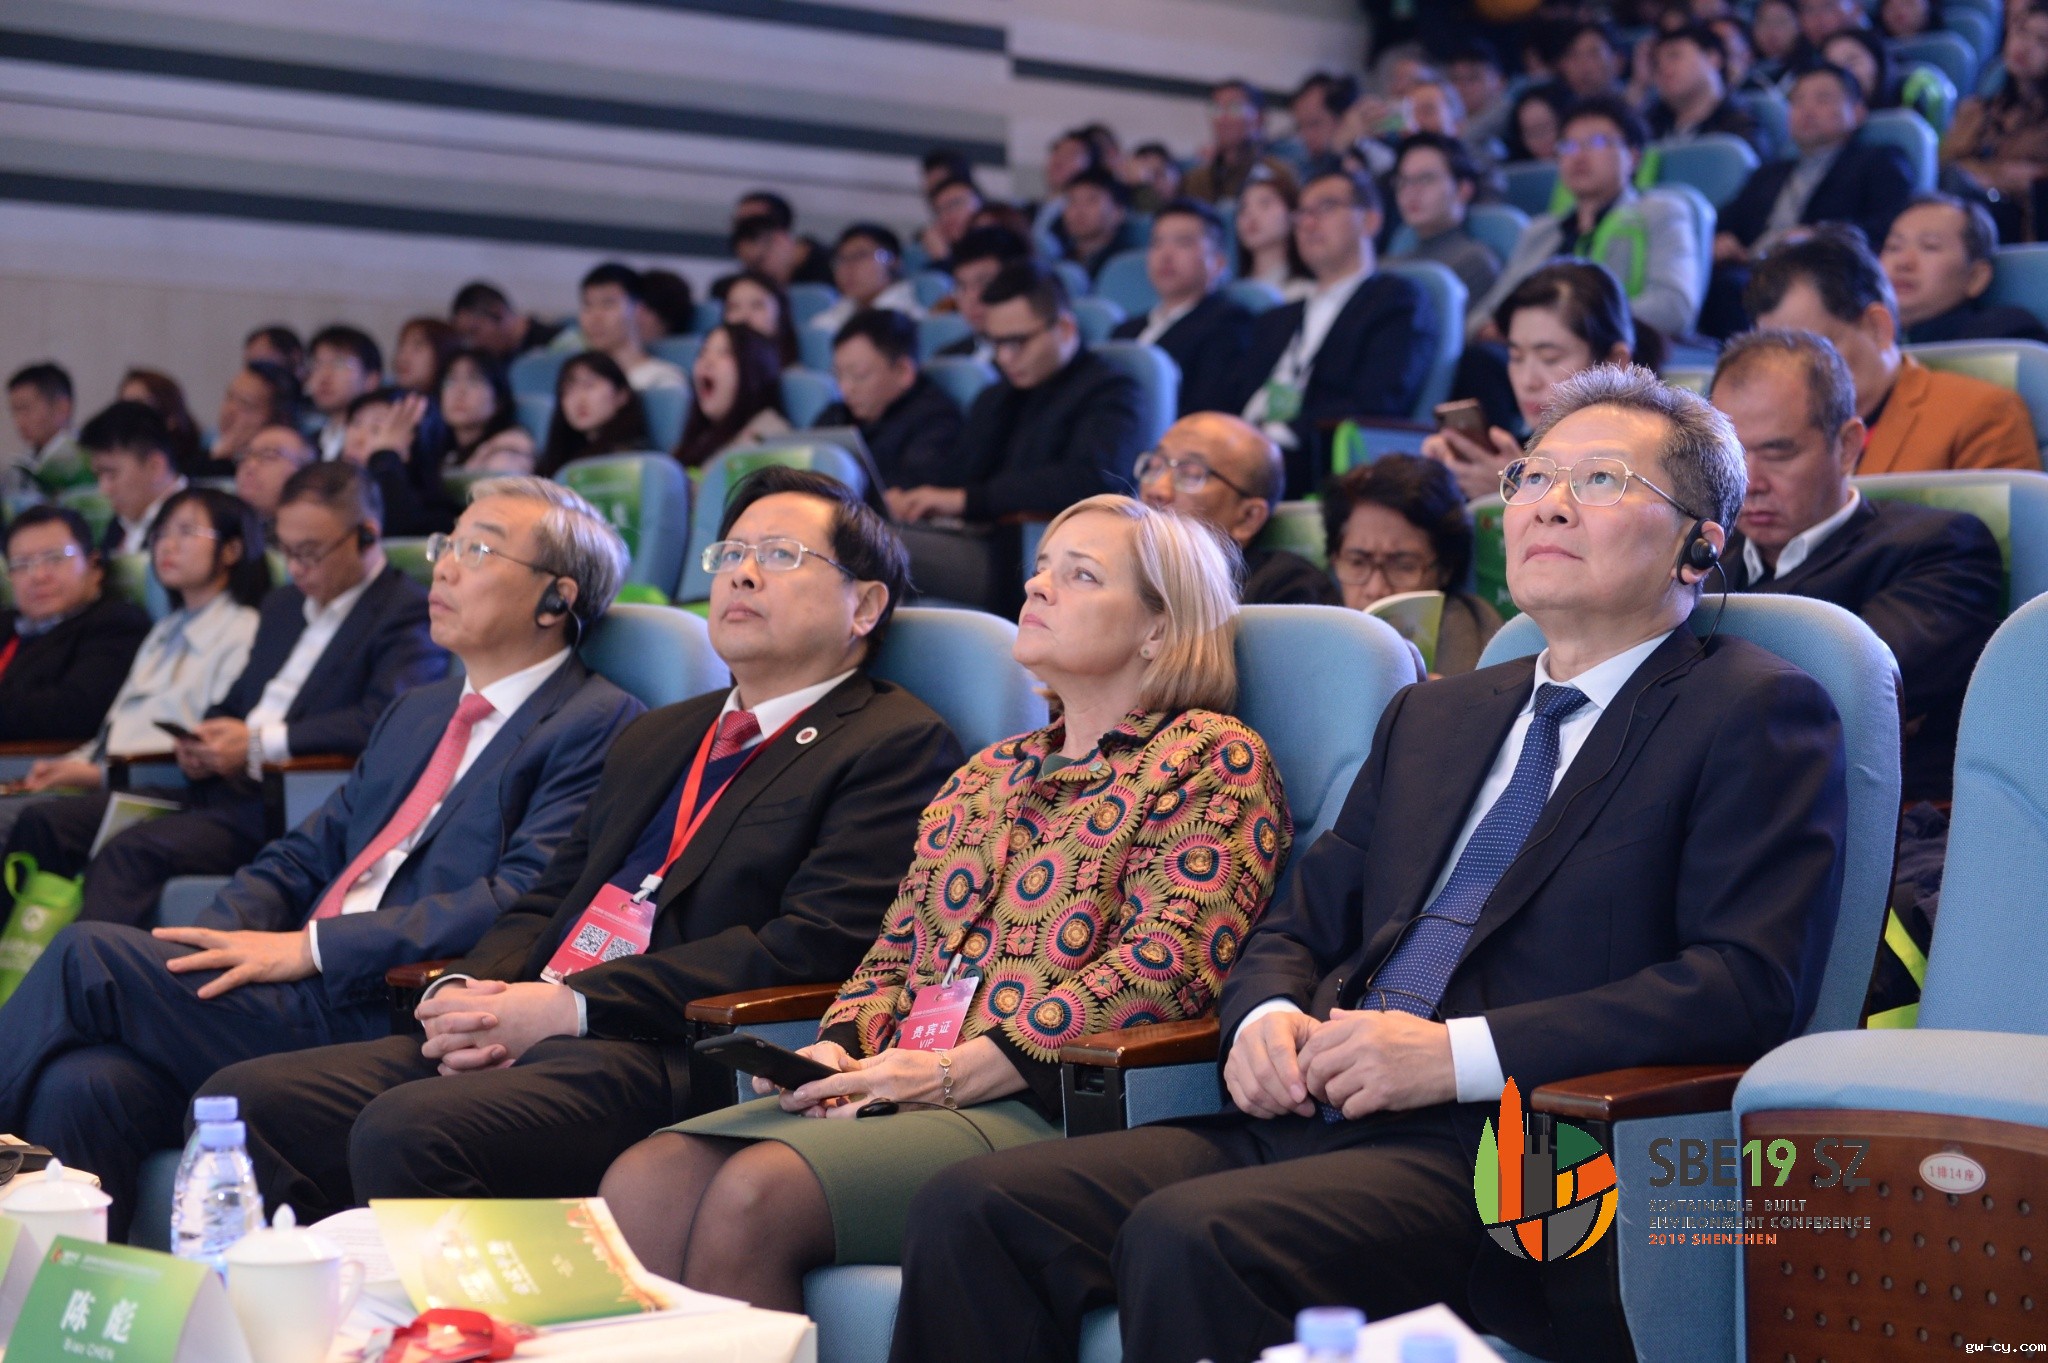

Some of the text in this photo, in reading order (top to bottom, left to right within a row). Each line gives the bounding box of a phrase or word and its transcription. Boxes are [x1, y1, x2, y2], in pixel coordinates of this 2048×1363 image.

[911, 1021, 952, 1040] 贵宾证
[919, 1038, 934, 1049] VIP
